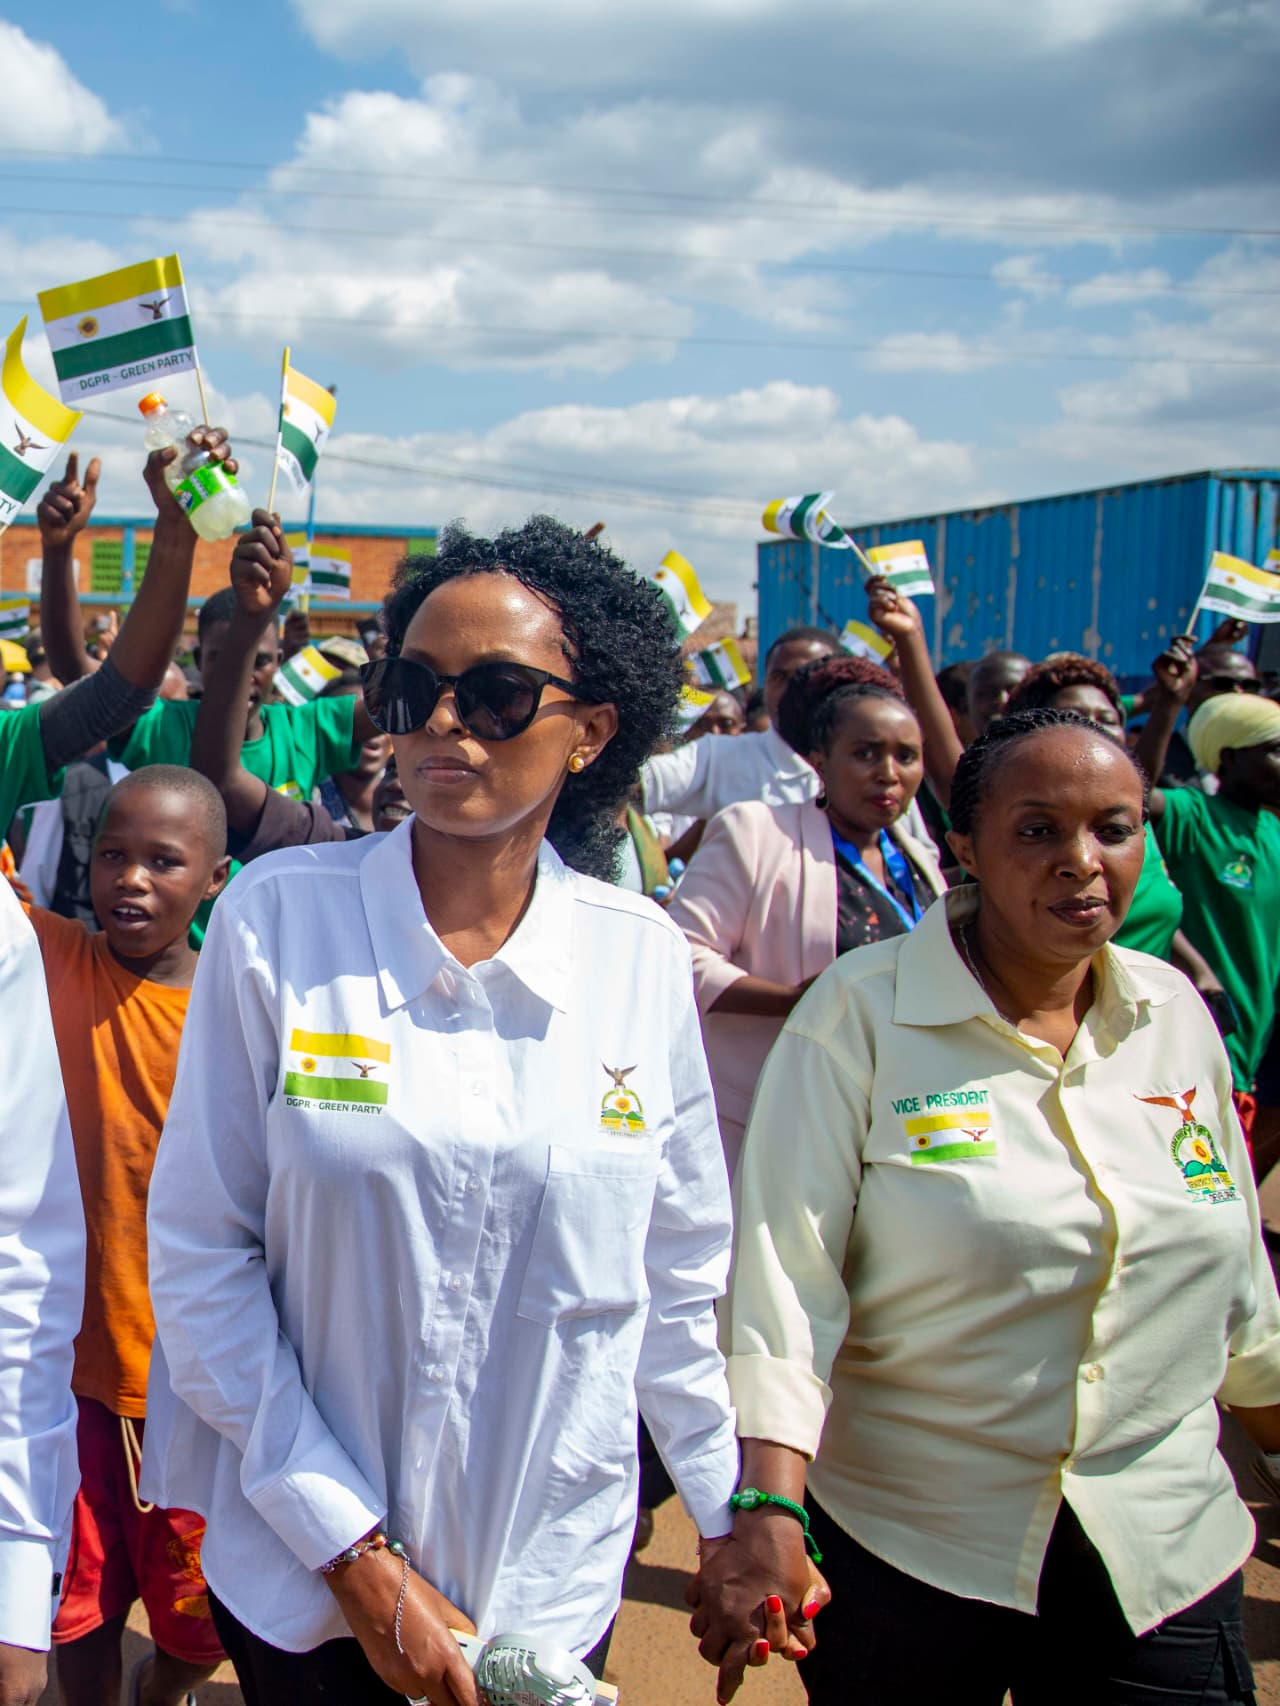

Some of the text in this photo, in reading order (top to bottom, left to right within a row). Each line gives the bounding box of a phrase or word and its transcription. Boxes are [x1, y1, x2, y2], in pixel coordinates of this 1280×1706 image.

[79, 373, 111, 390] DGPR
[120, 364, 157, 380] GREEN
[156, 351, 193, 368] PARTY
[286, 1097, 311, 1109] DGPR
[318, 1101, 350, 1112] GREEN
[351, 1104, 384, 1115] PARTY
[891, 1090, 989, 1115] VICE PRESIDENT
